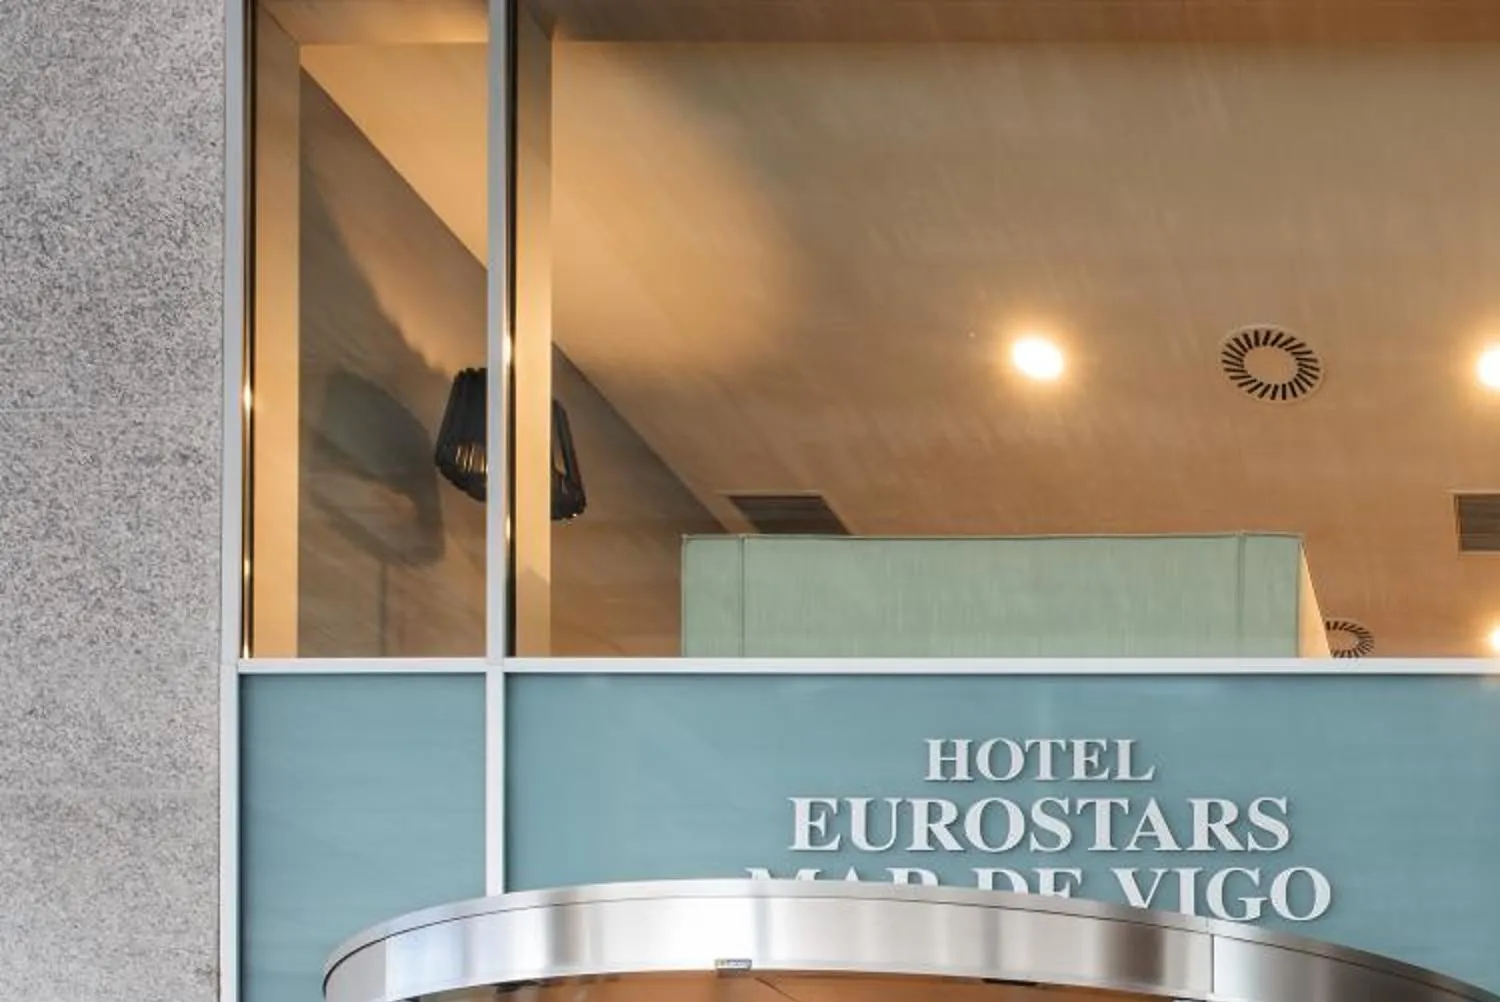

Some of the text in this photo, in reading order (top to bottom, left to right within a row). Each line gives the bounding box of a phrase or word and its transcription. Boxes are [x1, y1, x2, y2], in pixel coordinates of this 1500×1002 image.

[924, 738, 1156, 782] HOTEL
[788, 796, 1293, 852] EUROSTARS
[1110, 866, 1332, 922] VIGO
